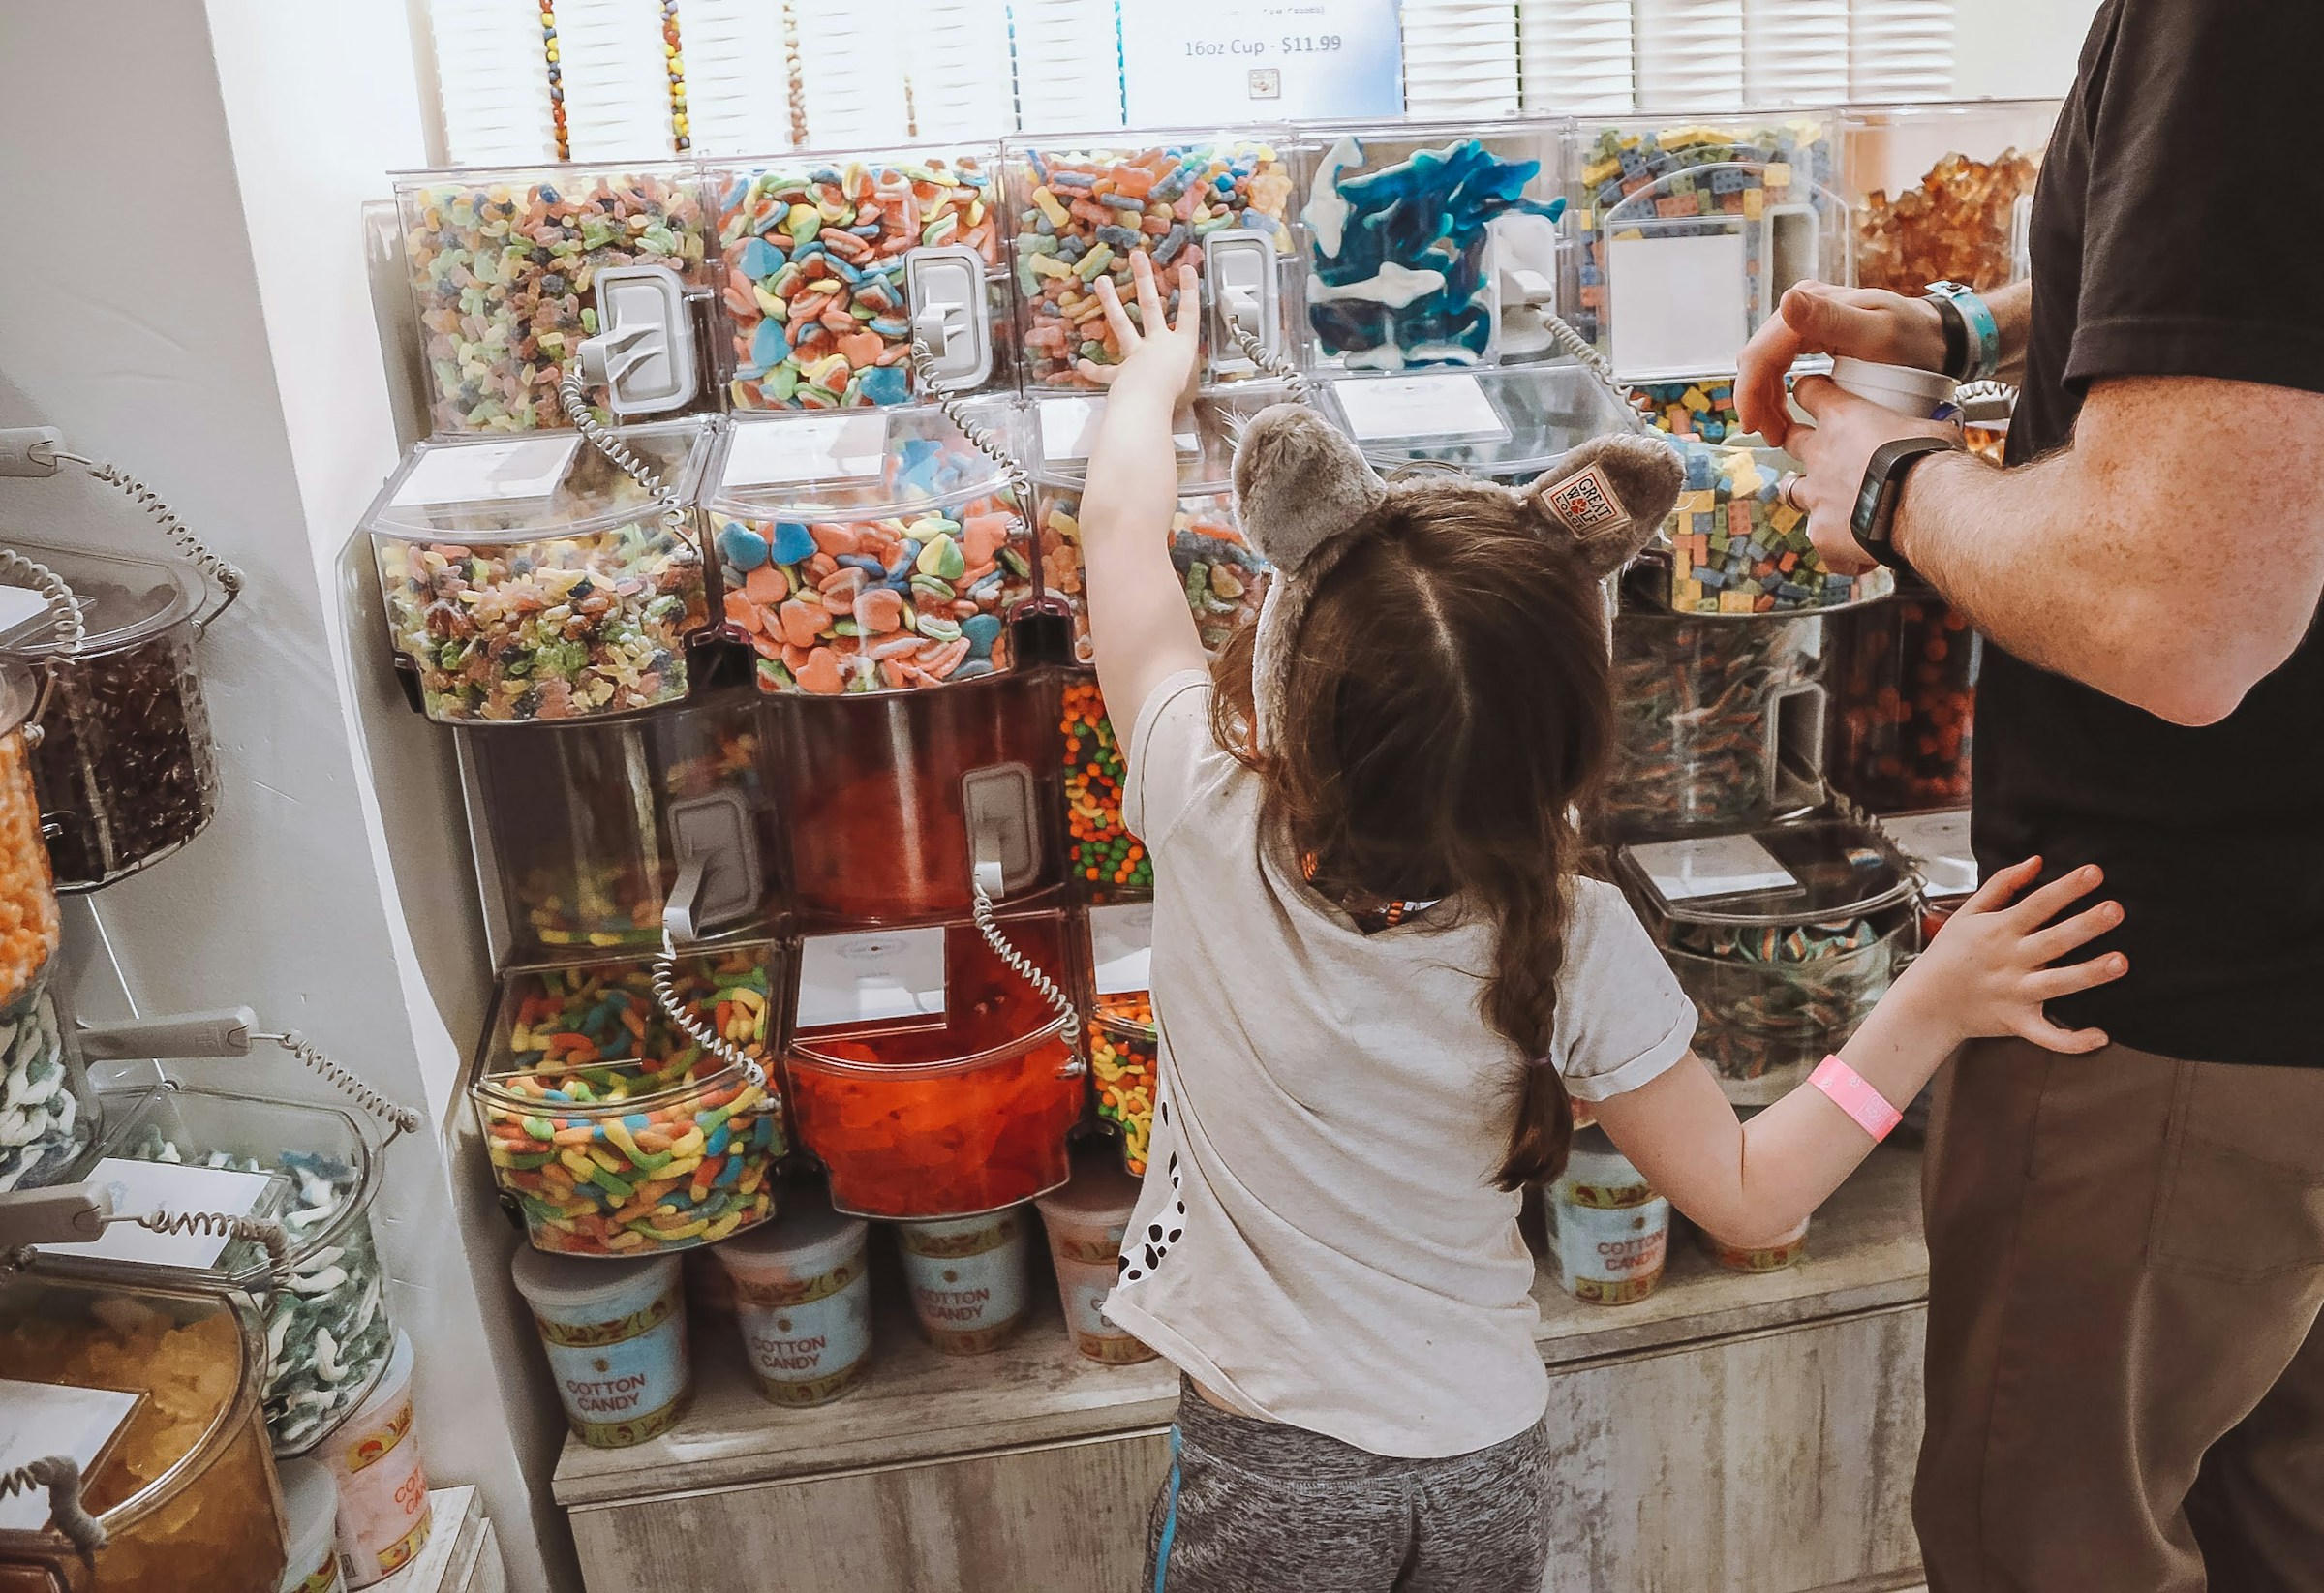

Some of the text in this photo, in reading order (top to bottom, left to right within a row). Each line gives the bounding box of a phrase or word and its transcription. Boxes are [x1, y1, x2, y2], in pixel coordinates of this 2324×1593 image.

[1184, 41, 1225, 56] 16oz
[1231, 38, 1265, 57] Cup
[1282, 35, 1342, 55] $11.99
[1578, 478, 1612, 518] GREAT
[751, 1335, 827, 1355] COTTON
[761, 1352, 821, 1370] CANDY
[566, 1372, 646, 1396] COTTON
[578, 1391, 640, 1412] CANDY
